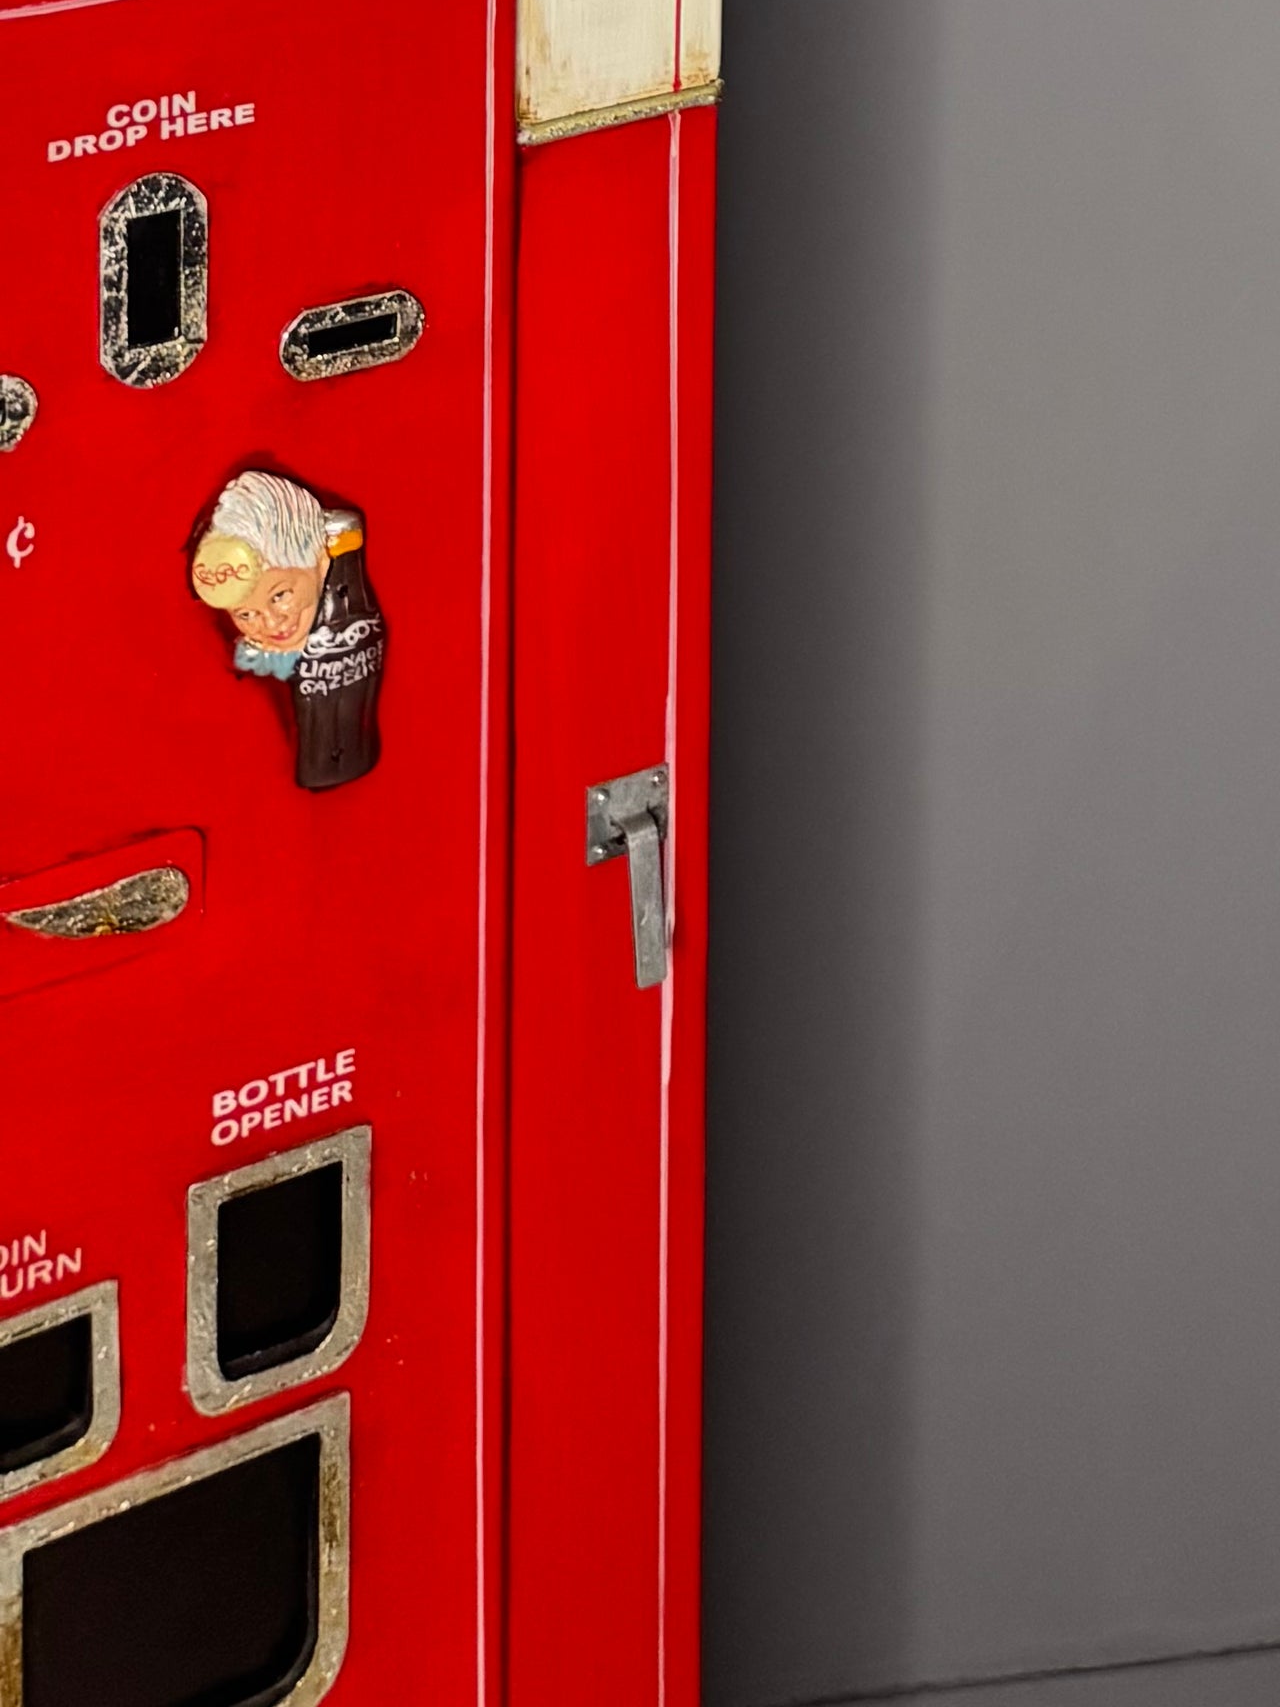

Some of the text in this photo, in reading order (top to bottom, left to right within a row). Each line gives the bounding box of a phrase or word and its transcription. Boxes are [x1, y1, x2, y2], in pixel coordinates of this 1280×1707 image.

[47, 102, 256, 163] DROP HERE
[106, 90, 197, 129] COIN
[210, 1079, 354, 1147] OPENER
[212, 1047, 357, 1118] BOTTLE
[0, 1246, 82, 1299] URN
